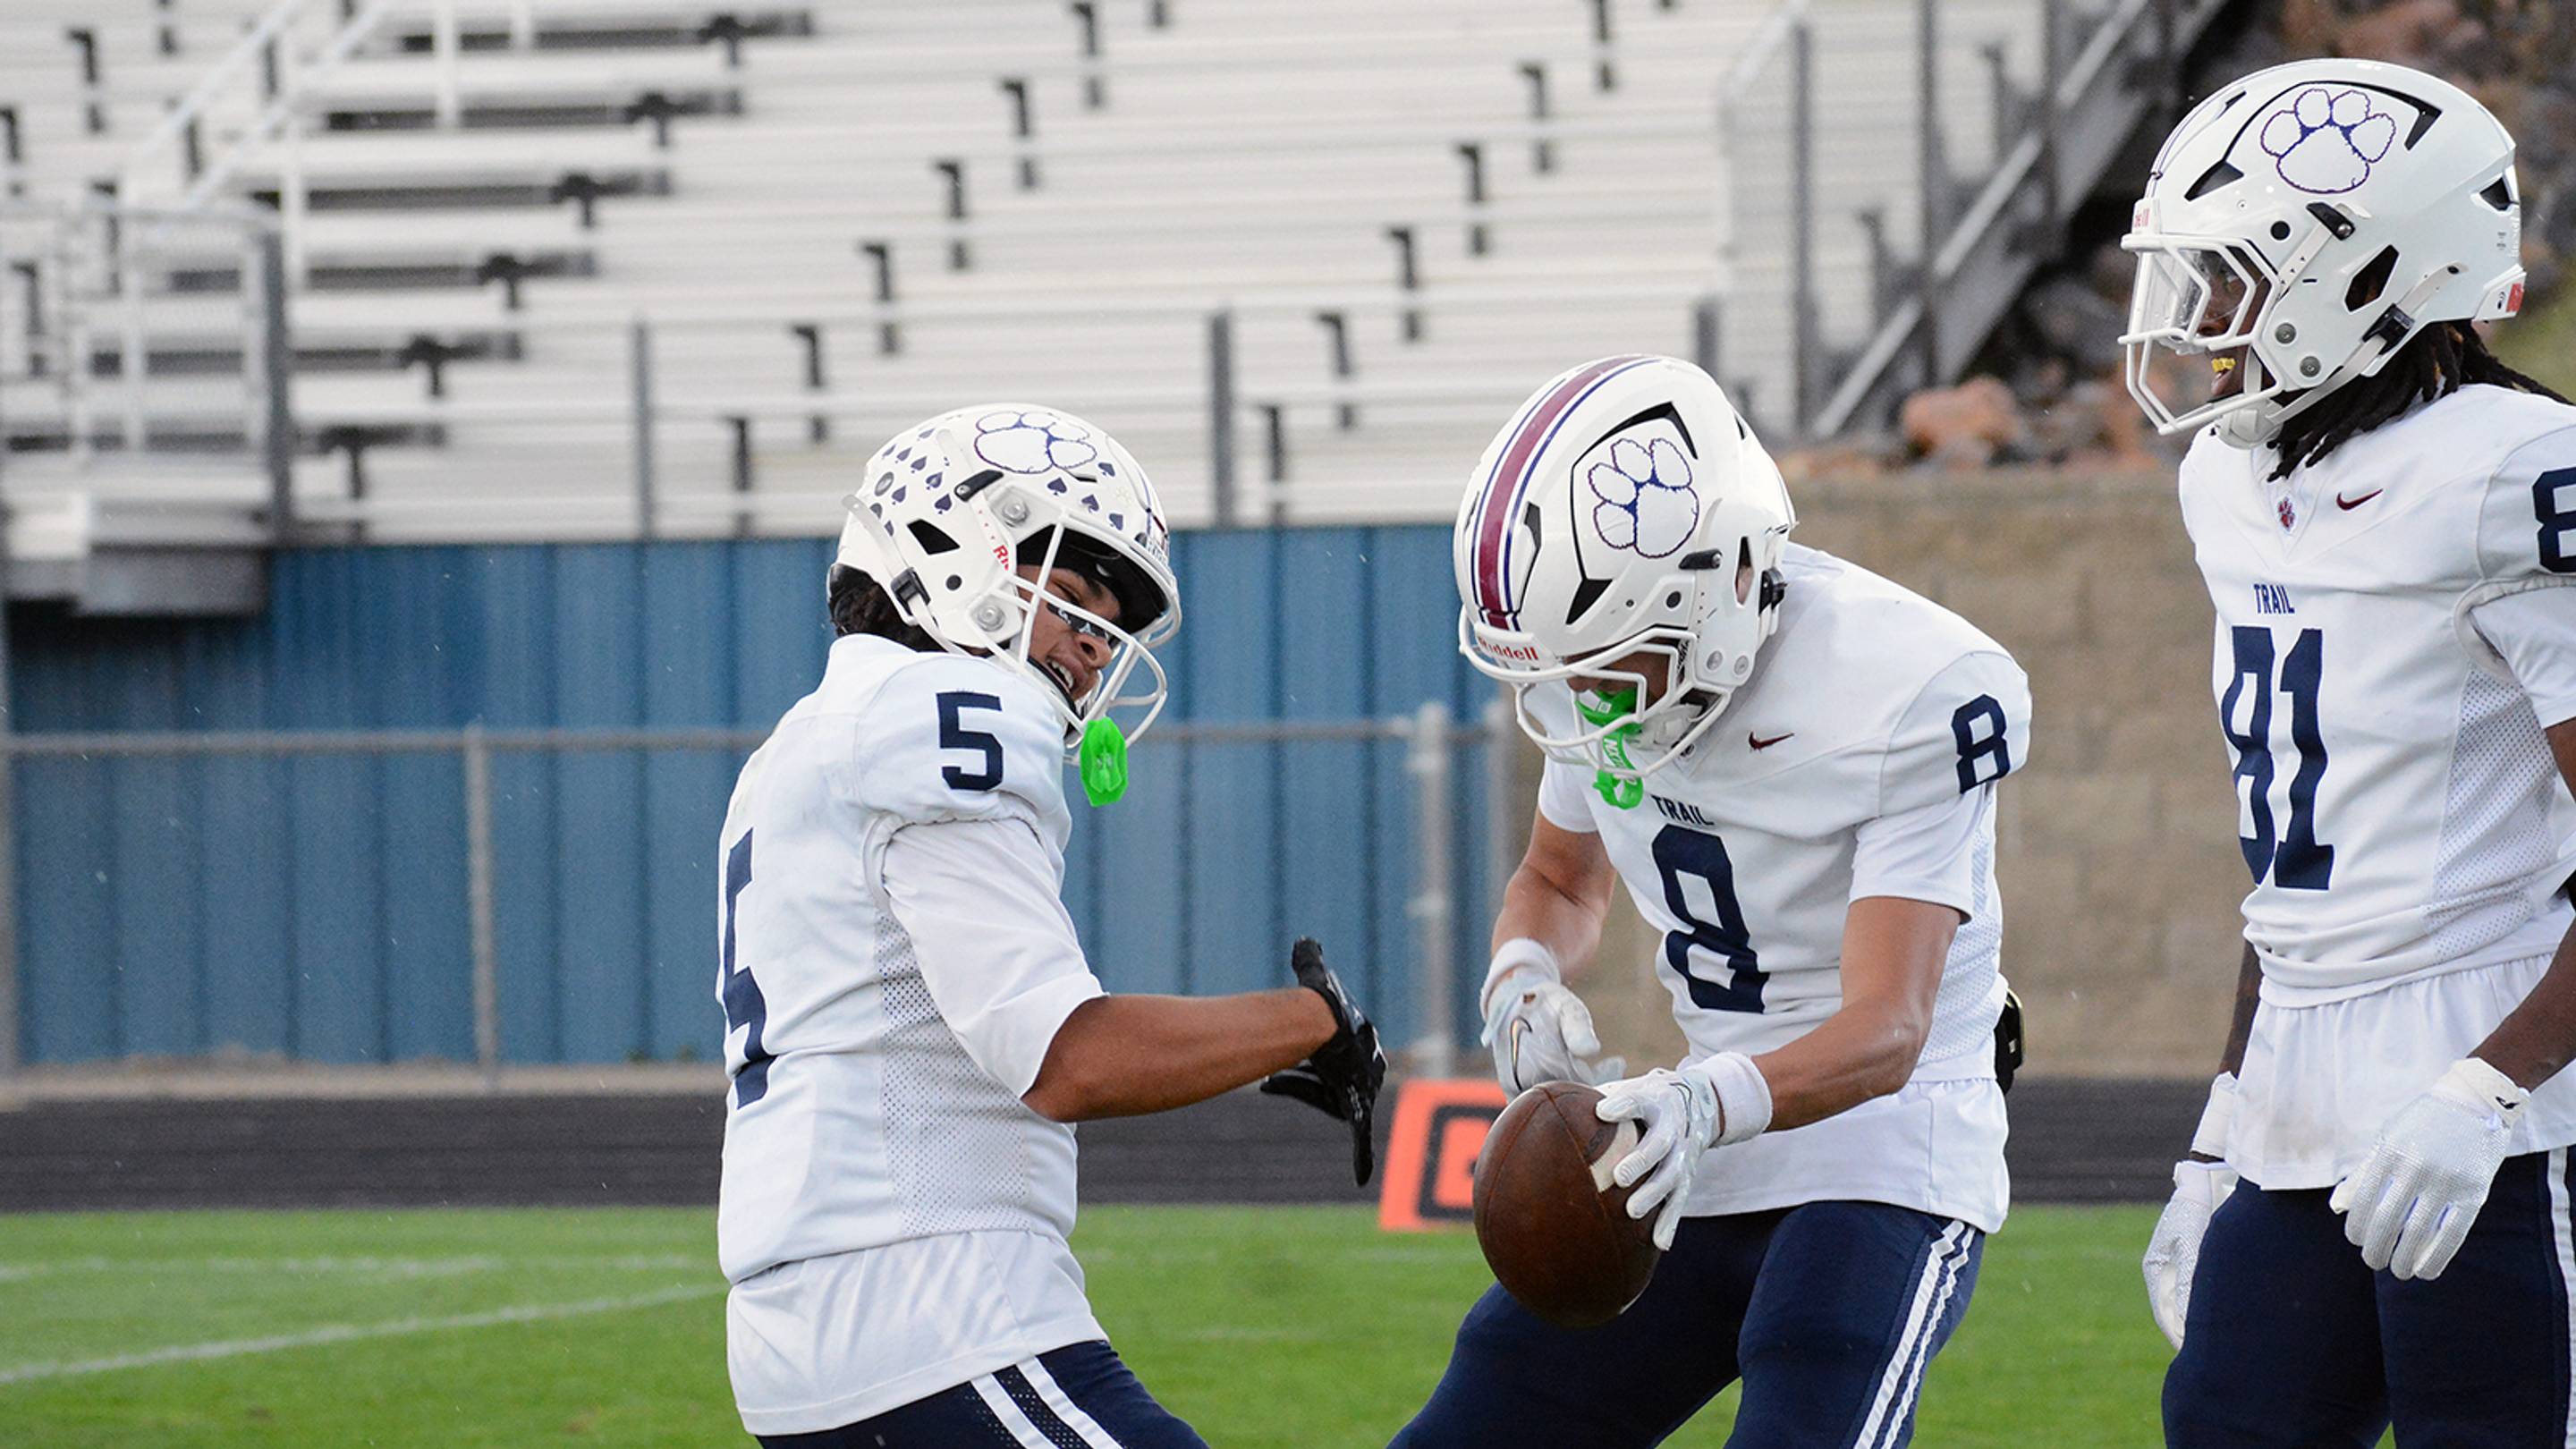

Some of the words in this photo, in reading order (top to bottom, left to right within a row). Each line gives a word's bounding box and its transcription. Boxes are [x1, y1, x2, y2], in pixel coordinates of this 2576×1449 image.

[2253, 583, 2296, 614] TRAIL
[935, 691, 1004, 792] 5
[1951, 693, 2012, 795] 8
[2221, 626, 2334, 891] 81
[1650, 793, 1716, 826] TRAIL
[1651, 823, 1771, 1015] 8
